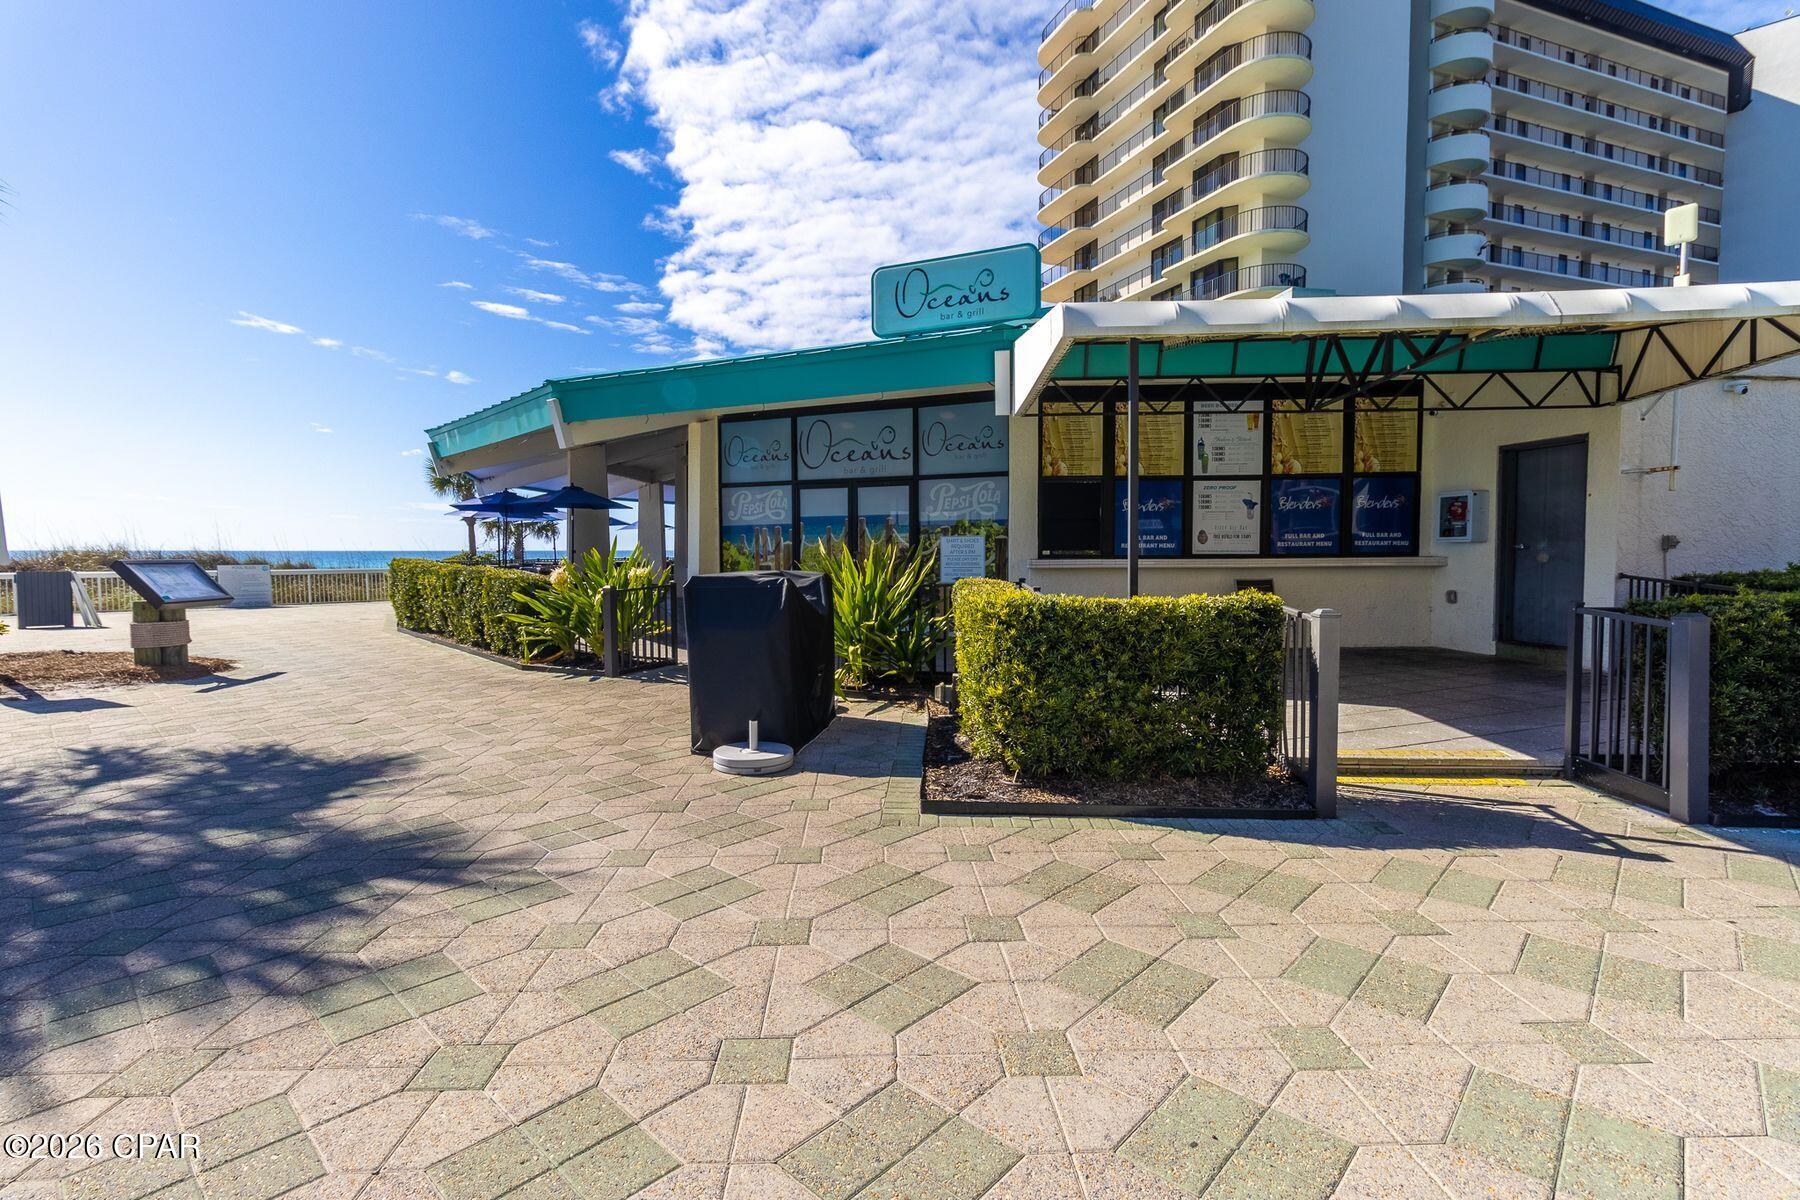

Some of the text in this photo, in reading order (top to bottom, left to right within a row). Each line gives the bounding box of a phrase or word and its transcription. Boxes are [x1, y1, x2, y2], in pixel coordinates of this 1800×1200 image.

[895, 268, 1010, 318] Oceans
[940, 308, 984, 320] bar & grill
[799, 419, 911, 469] Oceans
[922, 421, 1004, 456] Oceans
[724, 435, 790, 467] Oceans
[843, 466, 857, 474] bar
[869, 463, 887, 475] grill
[1278, 496, 1322, 510] Blenders
[1355, 495, 1399, 509] Blenders
